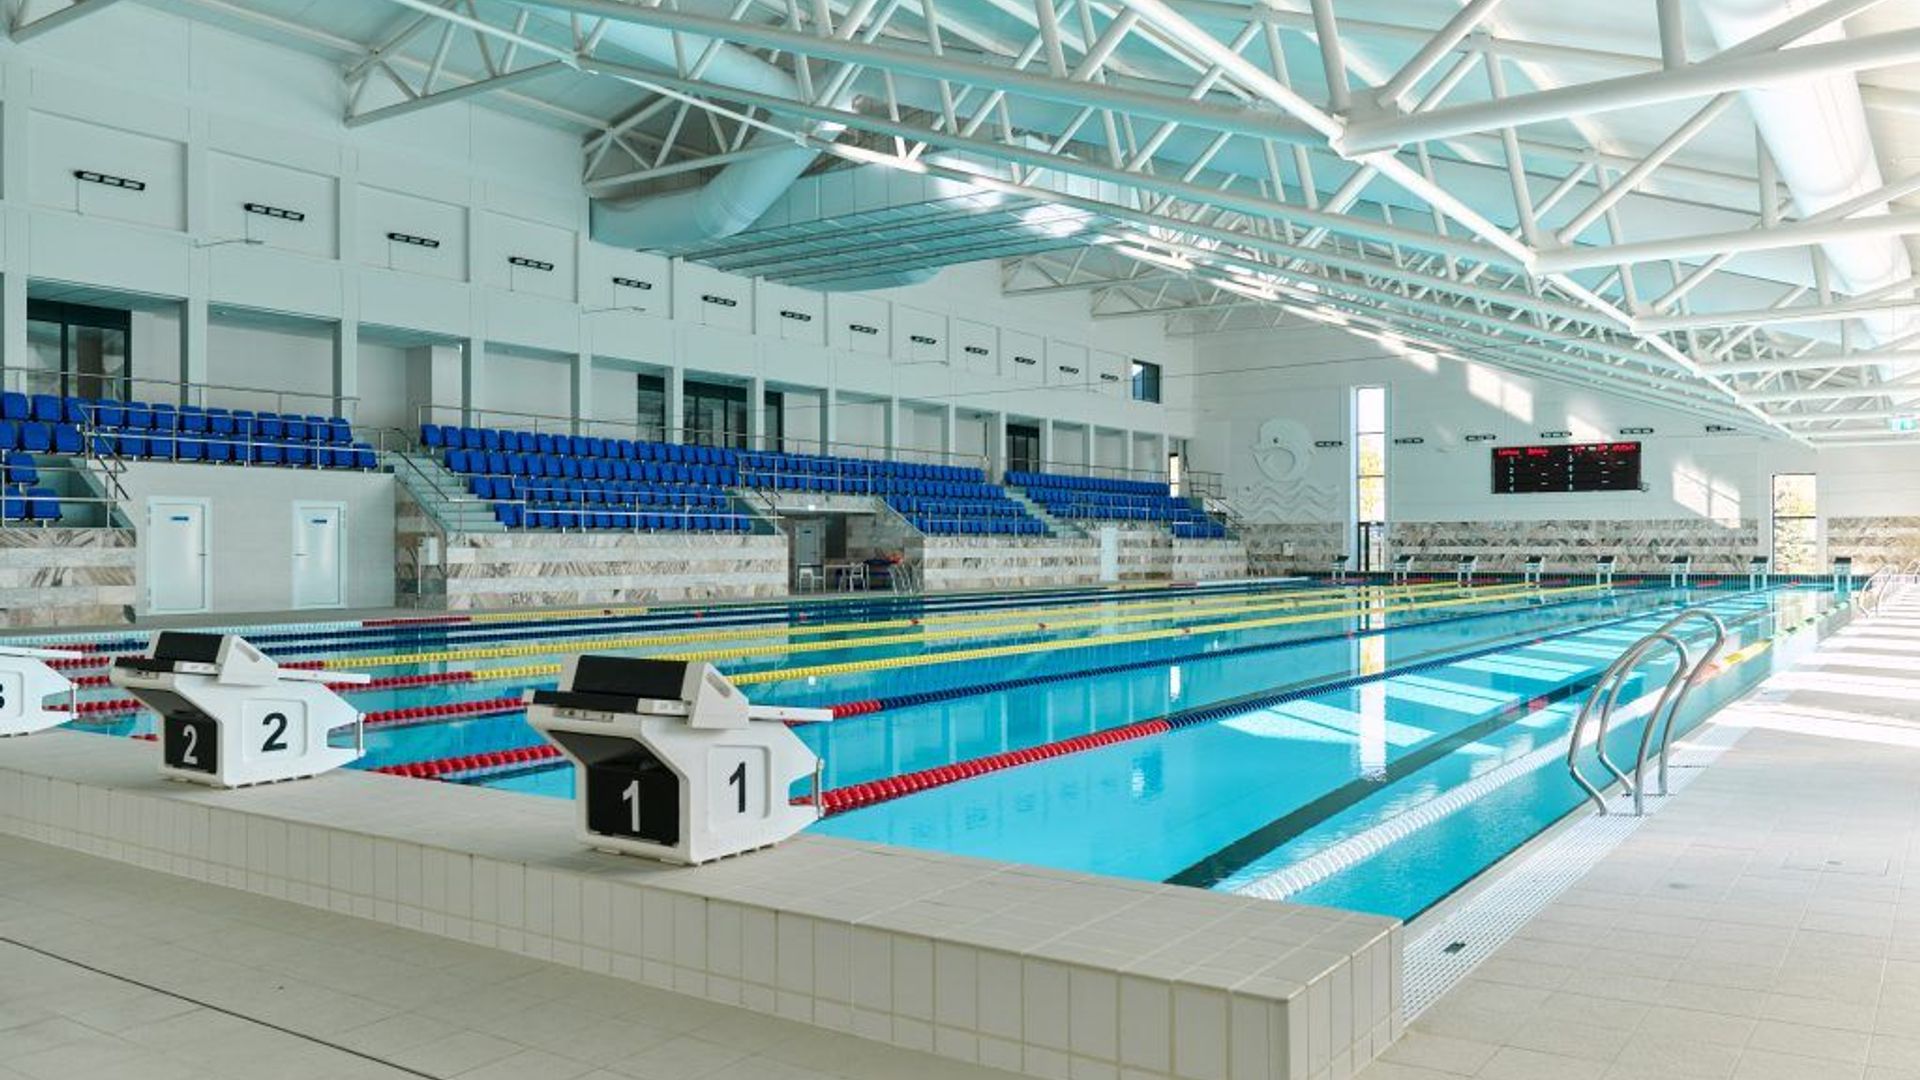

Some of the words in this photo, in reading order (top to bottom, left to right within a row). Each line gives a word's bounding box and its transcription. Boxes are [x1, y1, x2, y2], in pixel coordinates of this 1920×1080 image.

[183, 724, 198, 765] 2
[261, 712, 288, 753] 2
[622, 779, 640, 833] 1
[729, 761, 746, 814] 1
